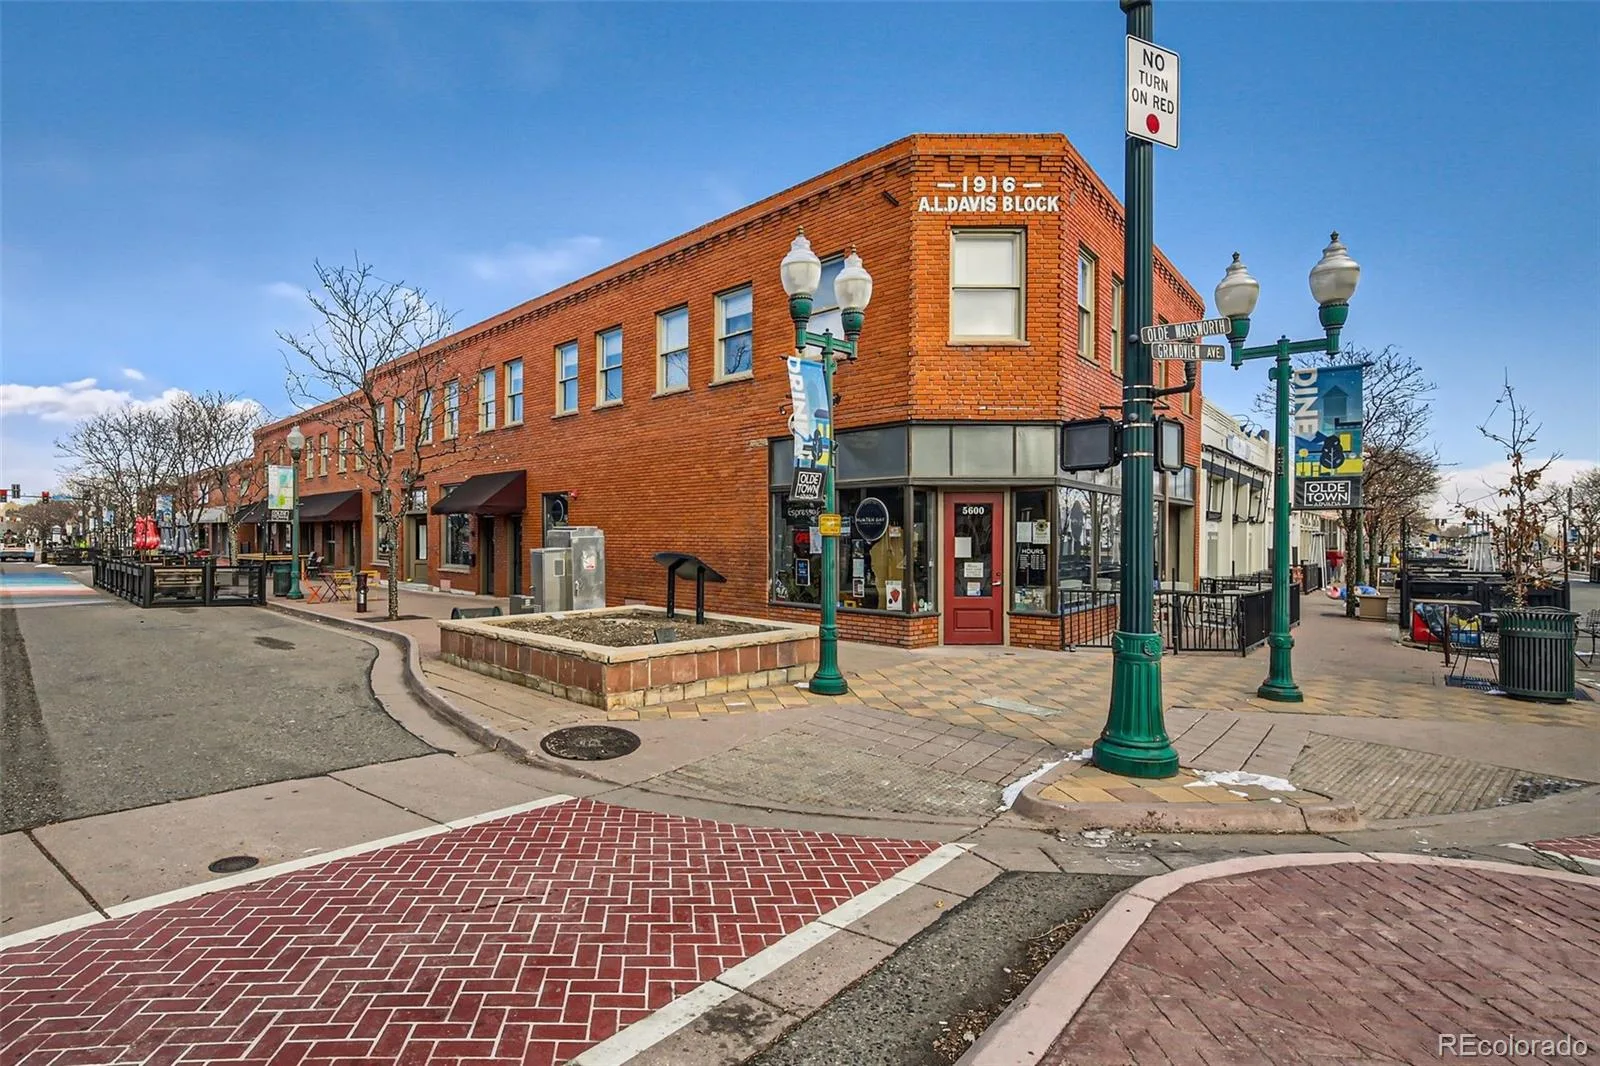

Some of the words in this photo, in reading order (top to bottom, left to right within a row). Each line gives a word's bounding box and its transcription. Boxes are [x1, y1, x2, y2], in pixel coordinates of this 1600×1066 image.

[1143, 48, 1165, 72] NO
[1139, 69, 1169, 93] TURN
[1131, 87, 1148, 106] ON
[1152, 94, 1175, 115] RED
[962, 175, 1017, 193] 1916
[1002, 196, 1061, 213] BLOCK
[1147, 325, 1170, 342] OLDE
[1174, 319, 1226, 339] WADSWORTH
[1157, 343, 1200, 359] GRANDVIEW
[1294, 368, 1319, 437] DINE
[800, 473, 820, 485] OLDE
[797, 484, 819, 495] TOWN
[1309, 483, 1346, 493] OLDE
[1306, 492, 1348, 502] TOWN
[962, 506, 985, 515] 5600
